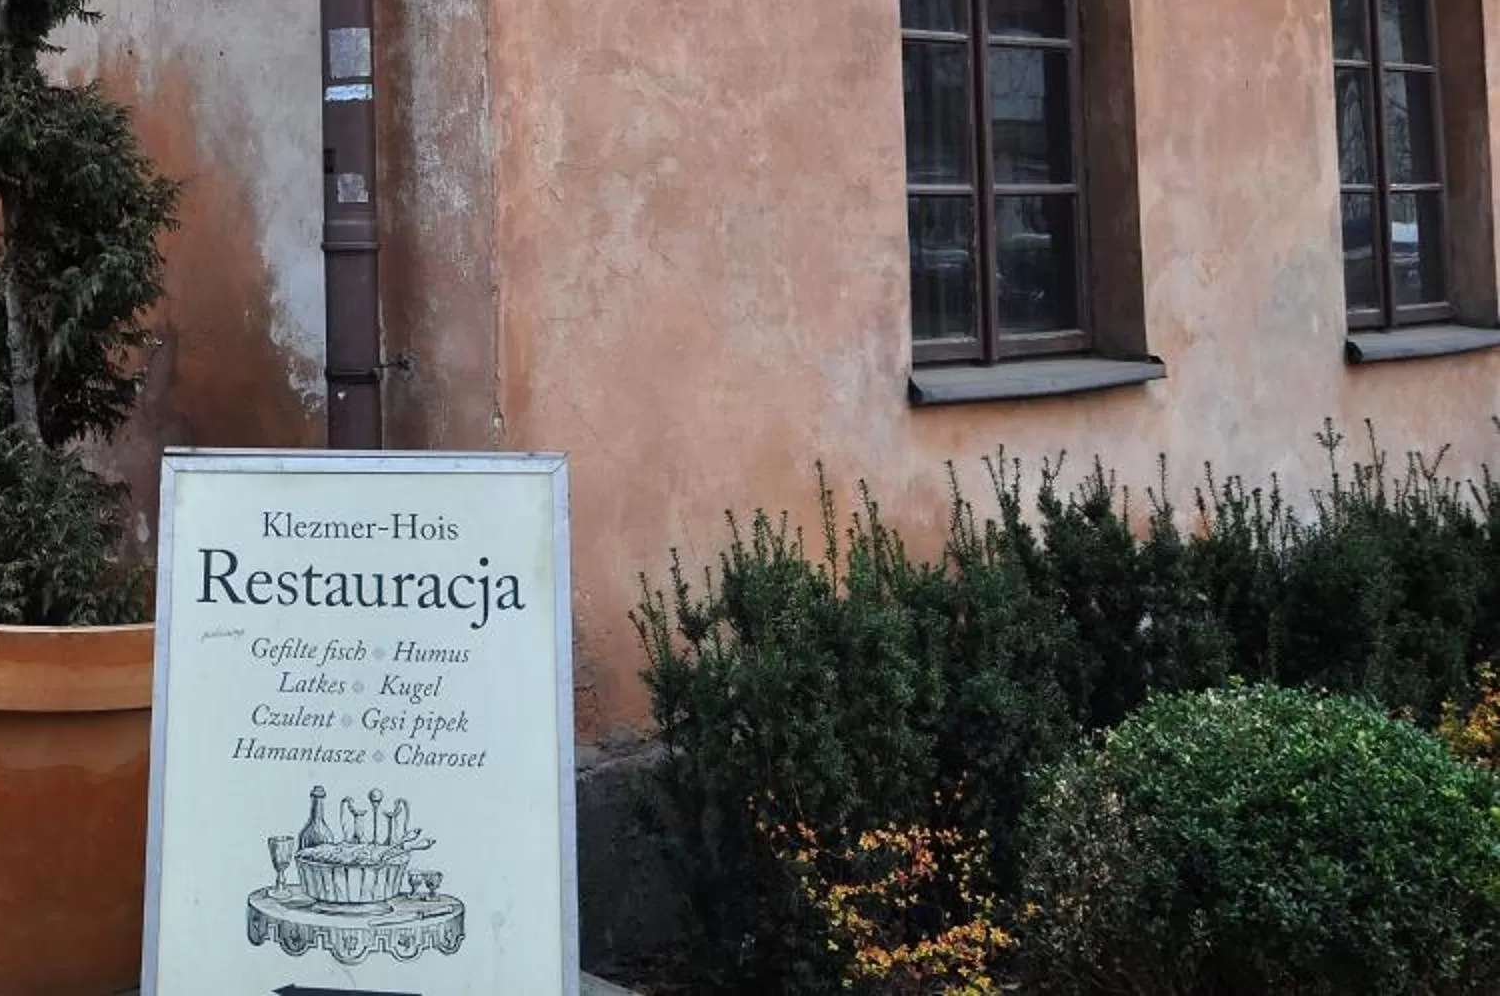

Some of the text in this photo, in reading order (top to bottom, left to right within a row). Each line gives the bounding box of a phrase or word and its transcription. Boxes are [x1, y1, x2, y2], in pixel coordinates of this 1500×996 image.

[261, 511, 459, 541] Klezmer-Hois
[196, 548, 526, 629] Restauracja
[251, 637, 470, 667] Gefilte fisch Humus
[277, 672, 443, 704] Latkes Kugel
[251, 704, 469, 741] Czulent Gęsi pipek
[231, 738, 487, 769] Hamantasze Charoset
